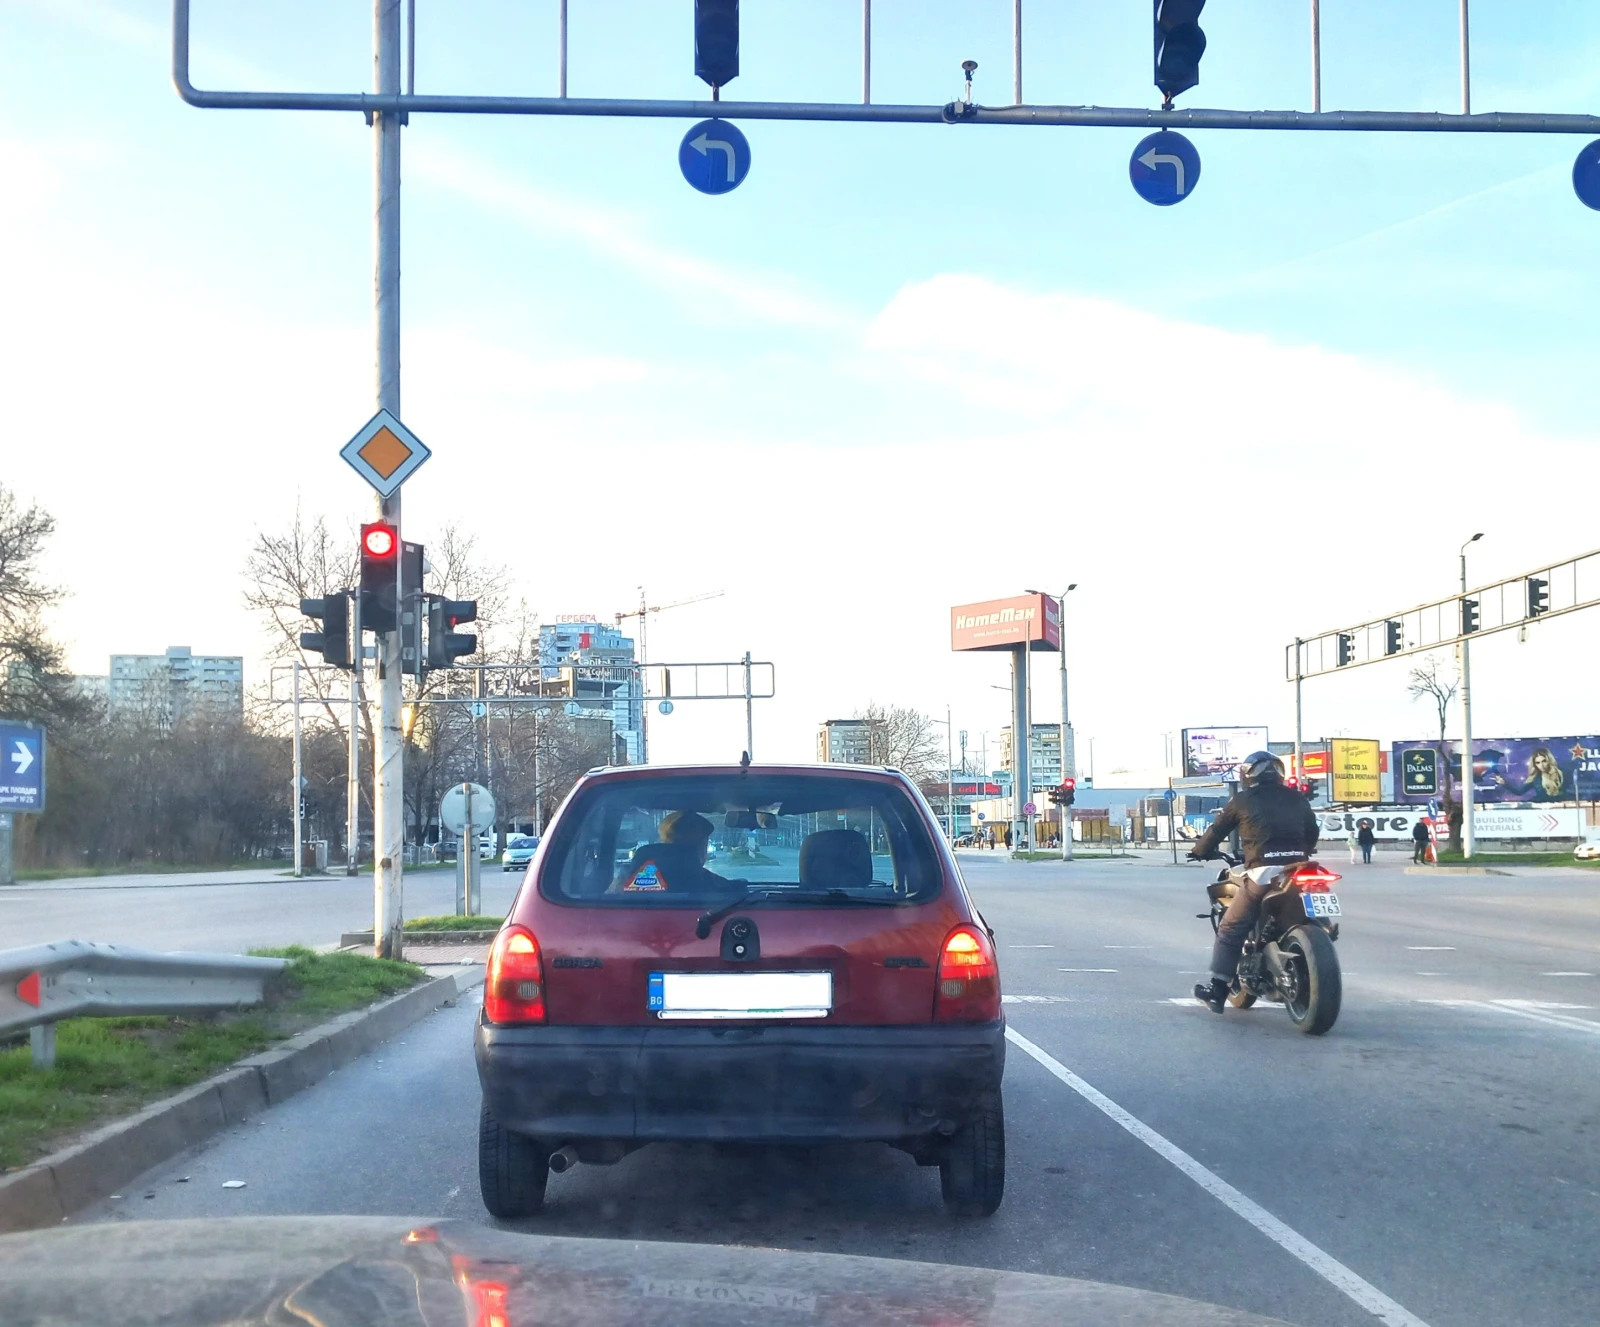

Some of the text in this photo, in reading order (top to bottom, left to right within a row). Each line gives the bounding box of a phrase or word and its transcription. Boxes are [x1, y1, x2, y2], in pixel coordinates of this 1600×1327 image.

[555, 614, 597, 623] ГЕРБЕРА
[955, 607, 1036, 630] HomeMax
[1406, 764, 1434, 773] PALMS
[1475, 816, 1523, 824] BUILDING
[1312, 895, 1338, 905] PB B
[1314, 905, 1340, 915] 5163
[883, 955, 931, 968] OPEL
[650, 996, 662, 1005] BG
